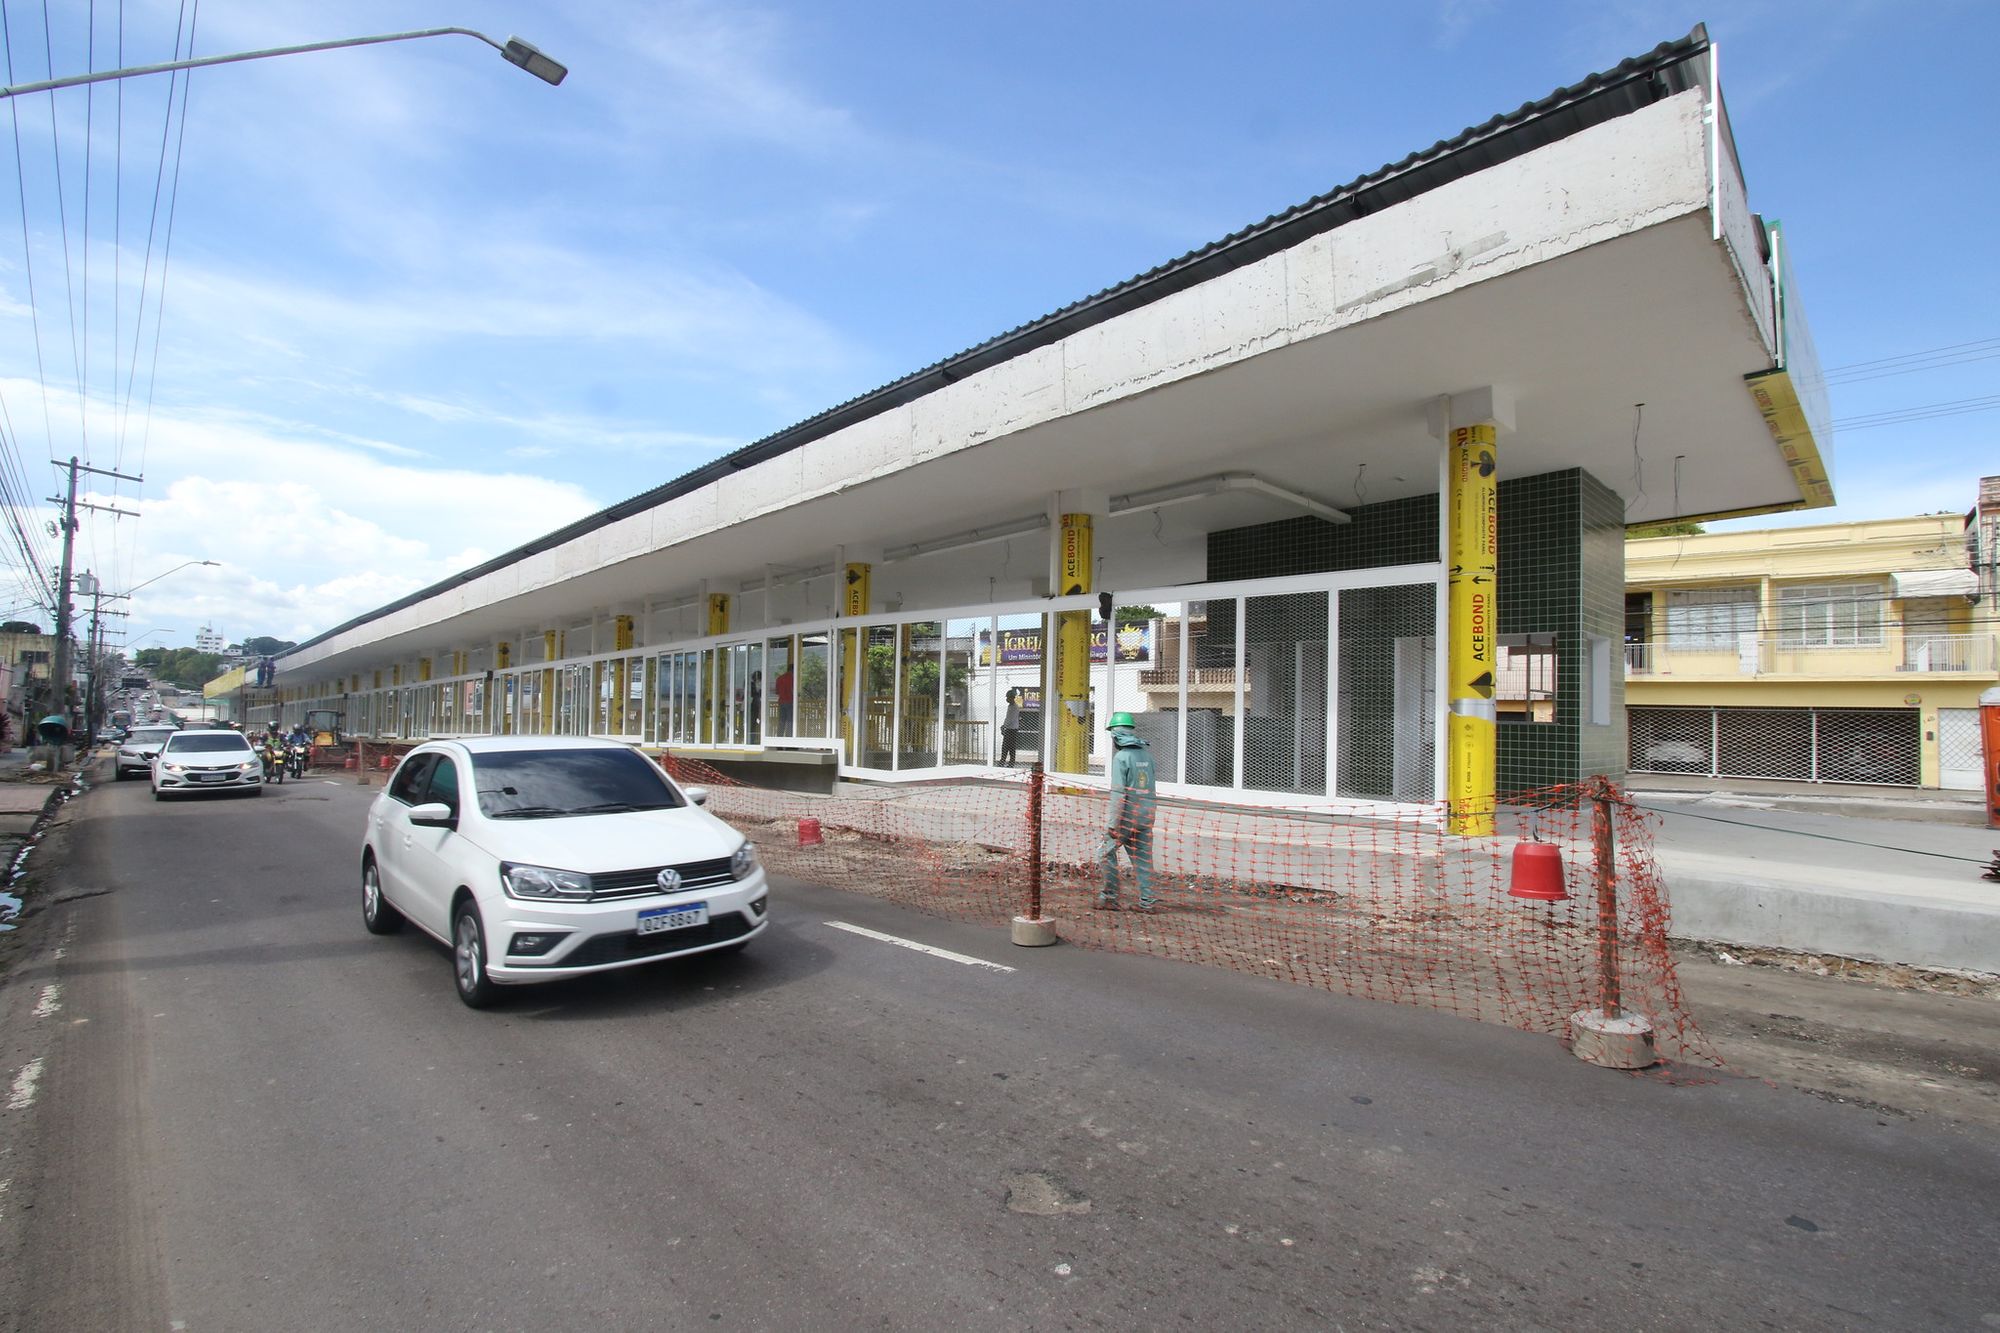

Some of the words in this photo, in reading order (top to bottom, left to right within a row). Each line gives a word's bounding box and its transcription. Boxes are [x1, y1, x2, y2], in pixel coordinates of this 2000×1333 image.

[1067, 530, 1075, 578] ACEBOND
[1488, 487, 1496, 555] ACEBOND
[1472, 593, 1484, 662] ACEBOND
